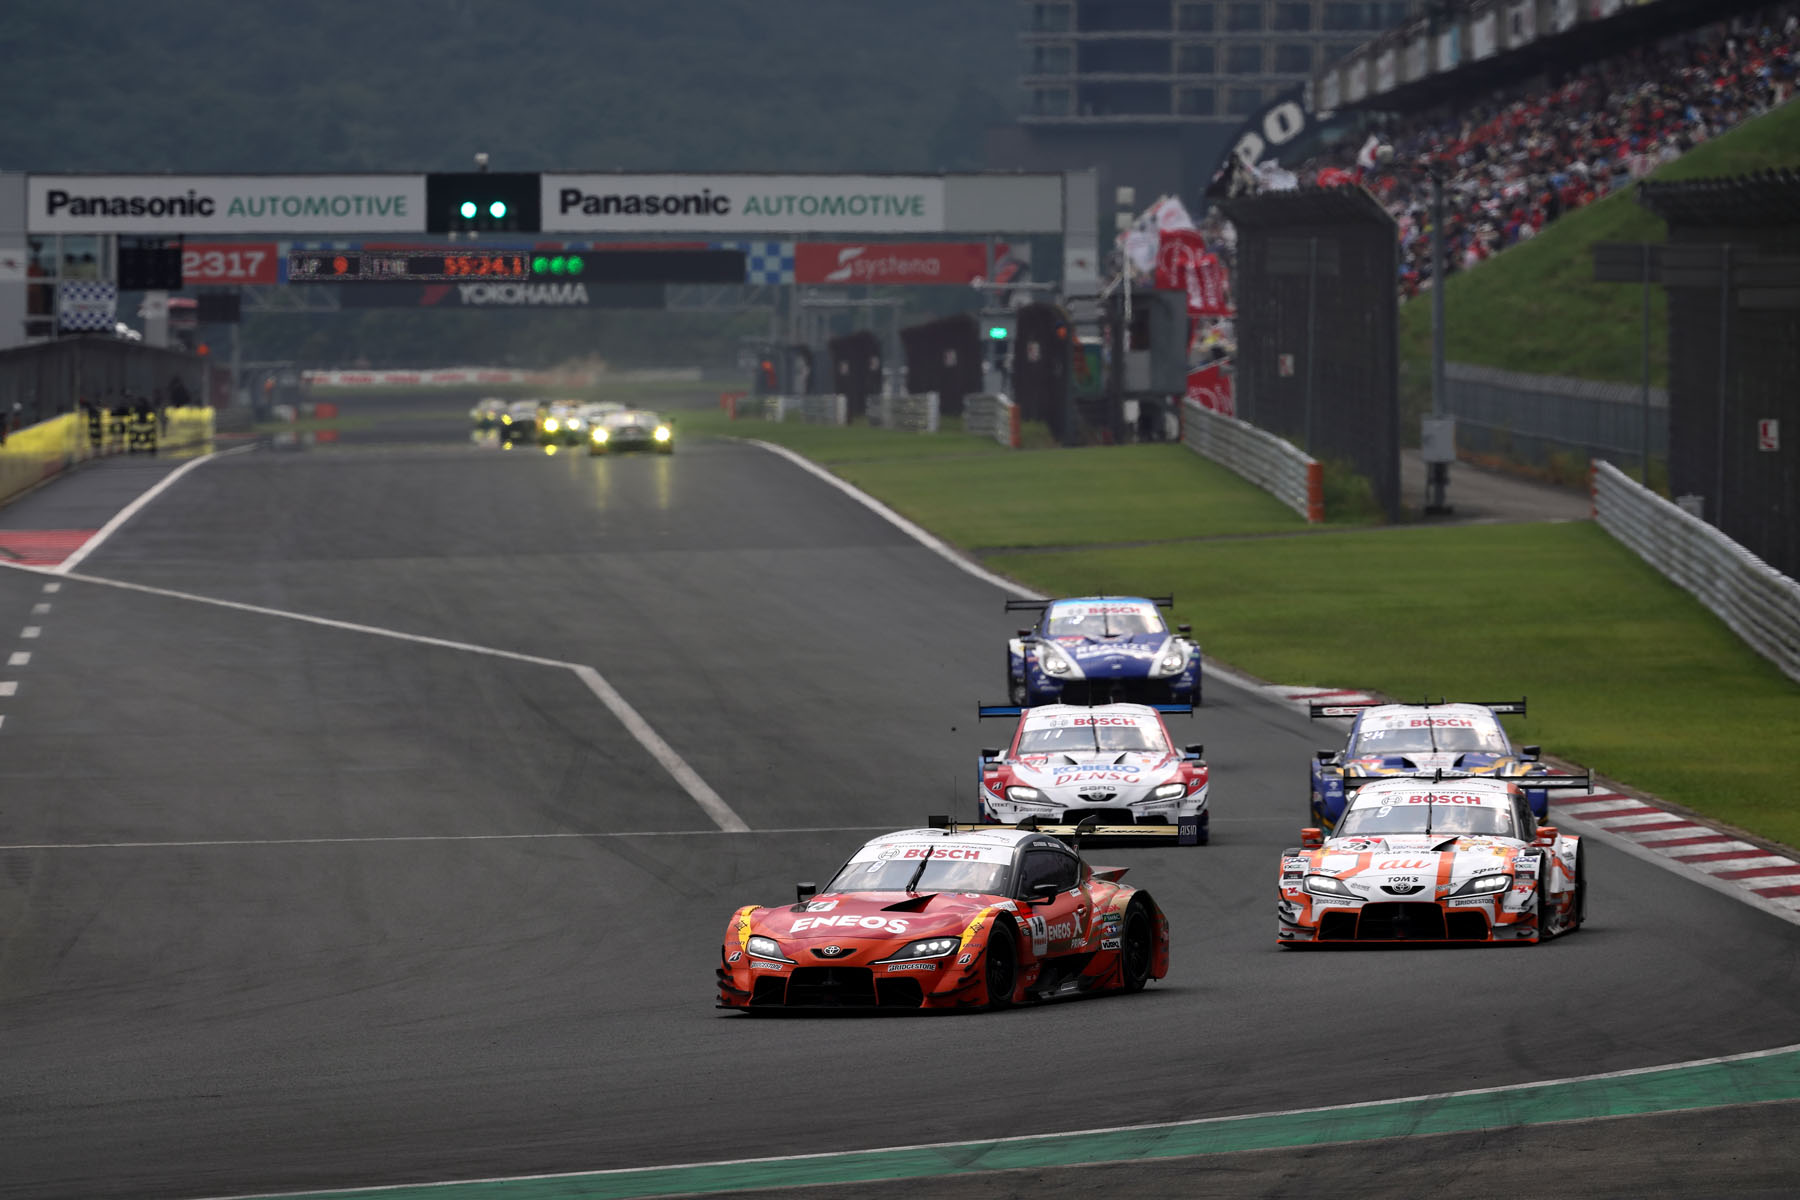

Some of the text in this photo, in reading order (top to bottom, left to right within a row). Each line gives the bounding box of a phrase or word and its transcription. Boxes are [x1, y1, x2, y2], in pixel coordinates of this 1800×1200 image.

[46, 189, 407, 217] Panasonic AUTOMOTIVE
[559, 187, 925, 217] Panasonic AUTOMOTIVE
[181, 251, 265, 277] 2317
[457, 282, 589, 304] YOKOHAMA
[1073, 718, 1136, 726] BOSCH
[1410, 718, 1472, 727] BOSCH
[1053, 764, 1141, 775] KOBELCO
[1055, 772, 1141, 786] DENSO
[1409, 795, 1481, 805] BOSCH
[903, 849, 981, 860] BOSCH
[1378, 859, 1432, 870] au
[789, 915, 910, 934] ENEOS
[1032, 916, 1045, 936] 14
[1048, 921, 1071, 941] ENEOS
